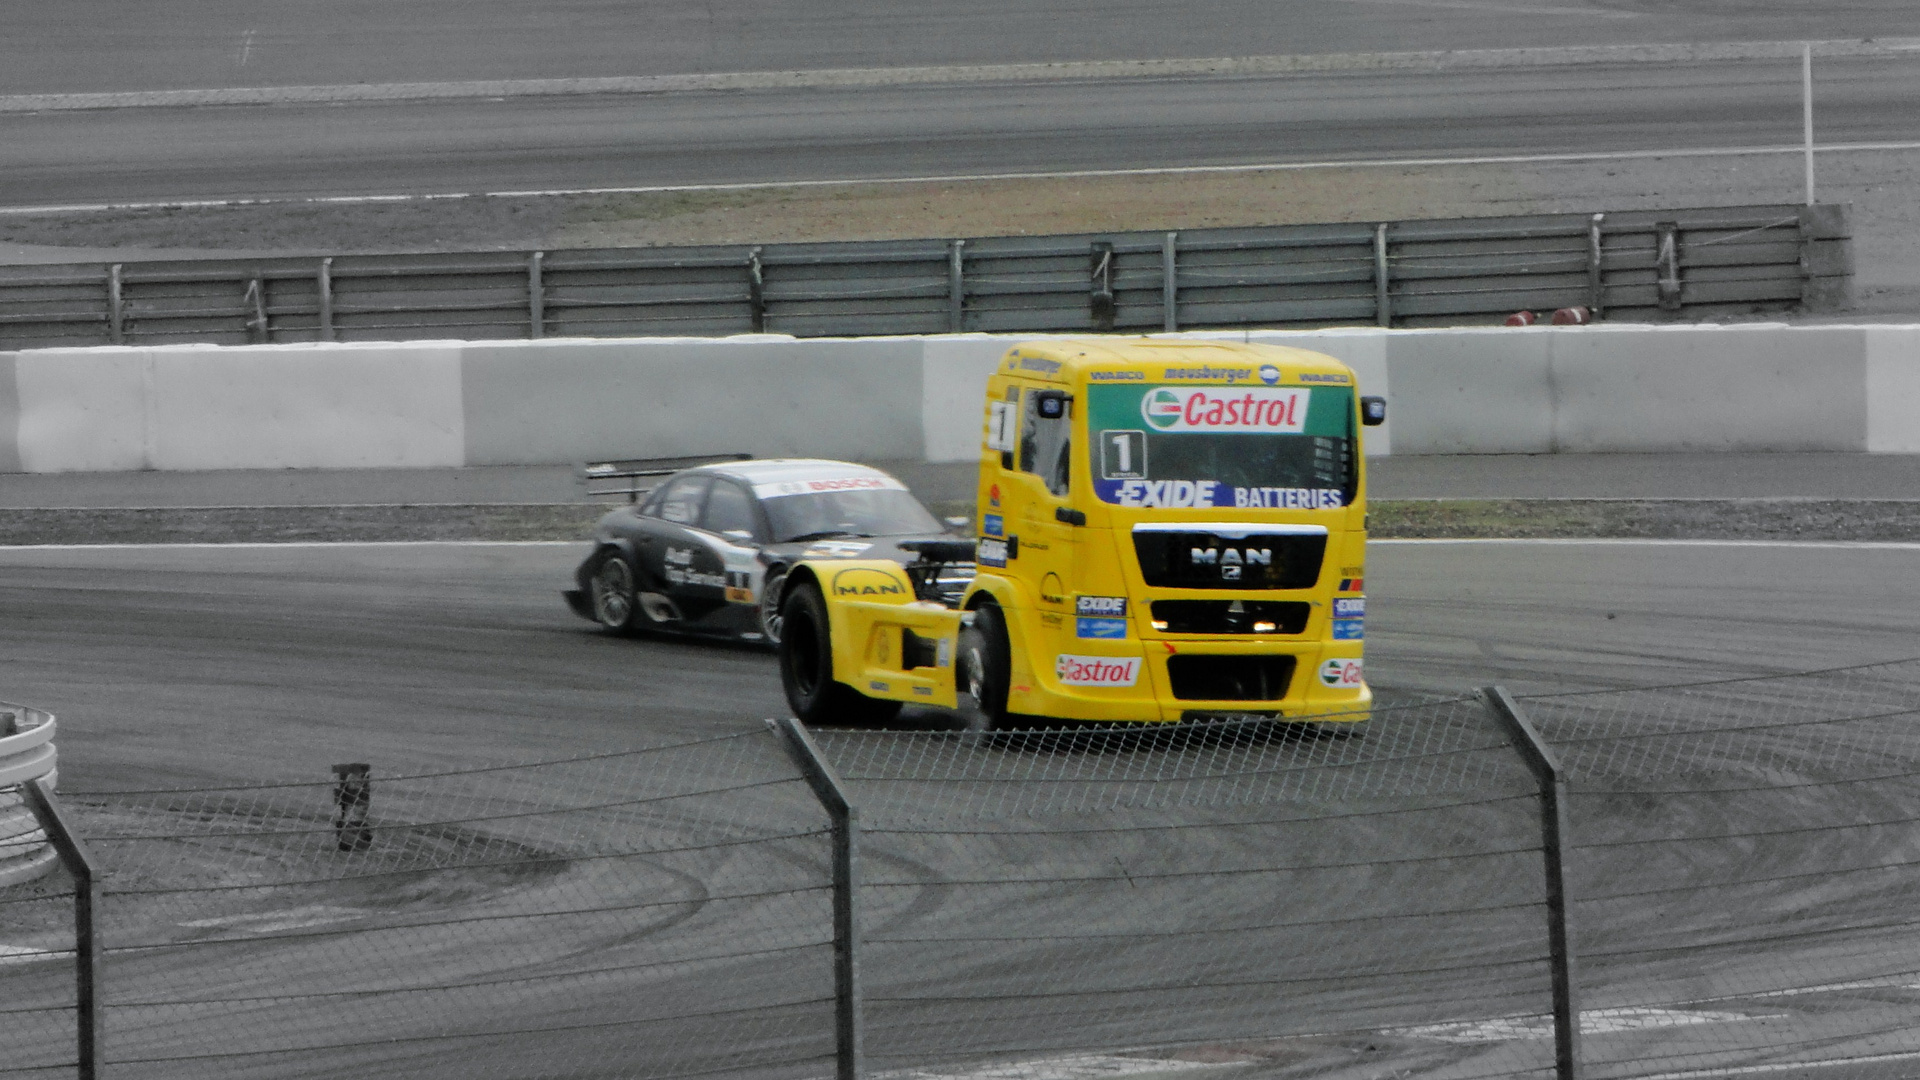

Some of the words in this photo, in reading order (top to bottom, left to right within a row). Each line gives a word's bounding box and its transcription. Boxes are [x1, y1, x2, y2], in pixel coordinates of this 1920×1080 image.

[1090, 371, 1145, 380] WABCO
[1164, 365, 1252, 384] meusburger
[1299, 374, 1348, 383] WABCO
[1184, 392, 1298, 426] Castrol
[1111, 433, 1131, 472] 1
[808, 479, 884, 491] BOSCH
[1115, 479, 1217, 508] EXIDE
[1234, 486, 1342, 510] BATTERIES
[1190, 547, 1272, 565] MAN
[838, 585, 899, 595] MAN
[1078, 597, 1125, 611] EXIDE
[1065, 658, 1133, 682] Castrol
